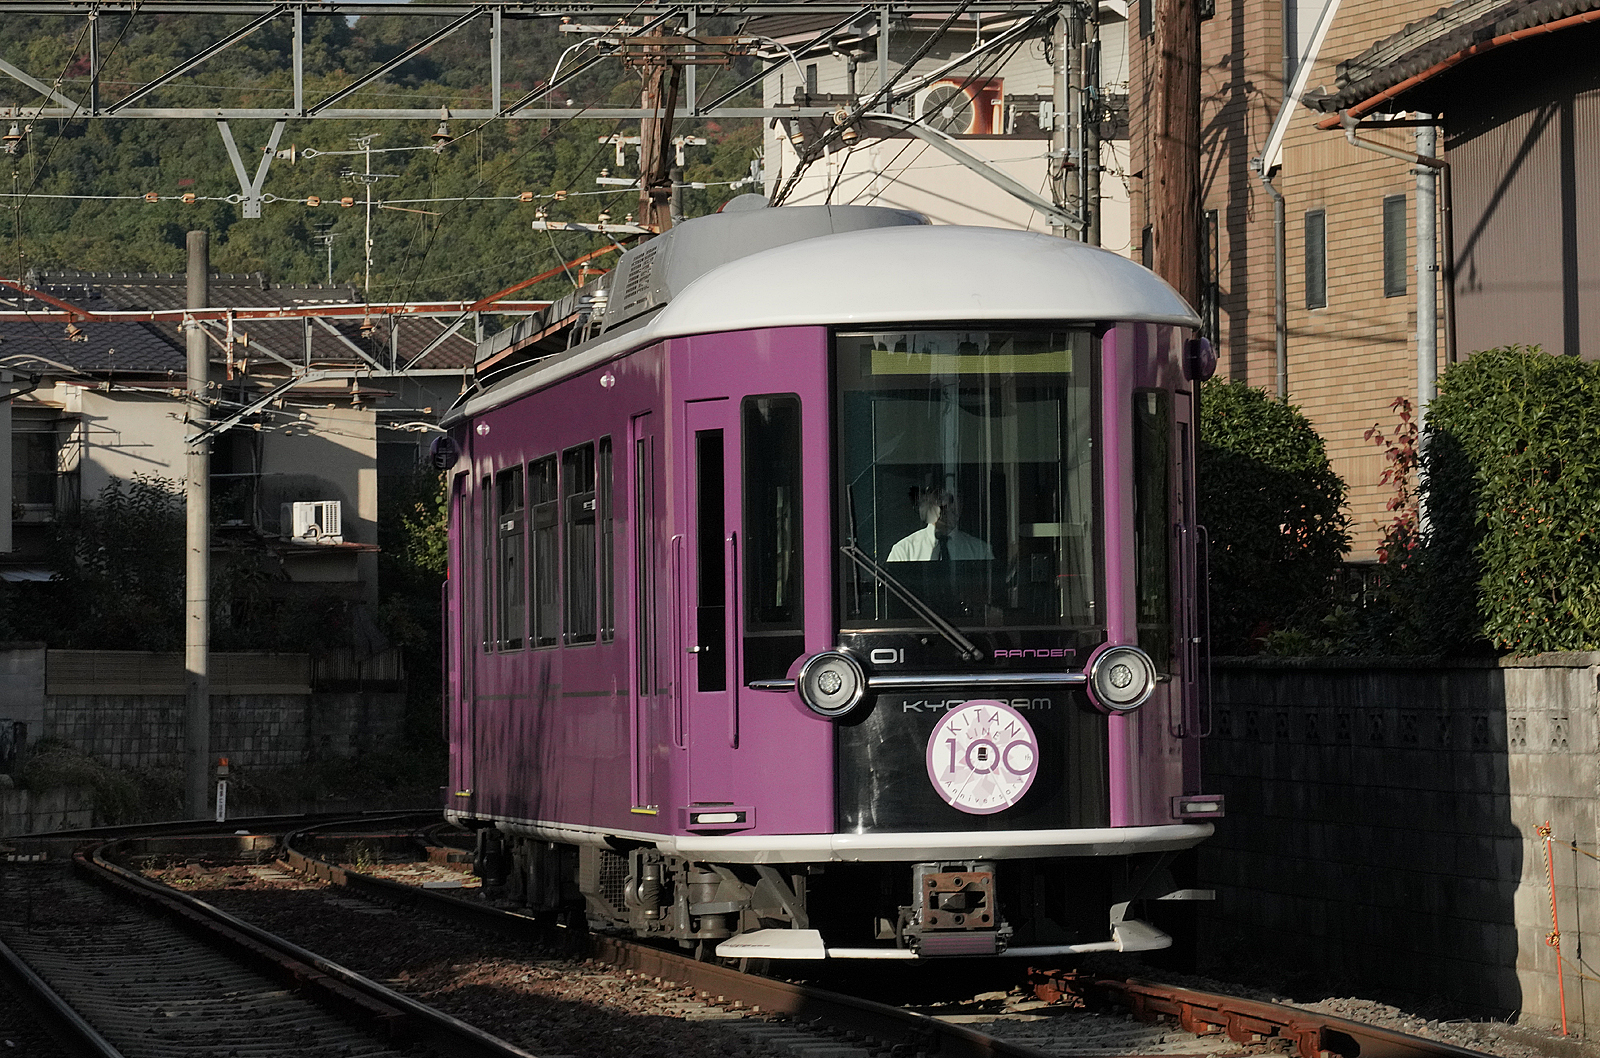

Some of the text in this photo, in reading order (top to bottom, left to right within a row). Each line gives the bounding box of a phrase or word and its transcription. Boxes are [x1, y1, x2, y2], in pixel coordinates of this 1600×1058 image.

[994, 649, 1077, 658] RANDEN
[966, 727, 1001, 740] LINE
[944, 776, 1024, 804] Anniversary
